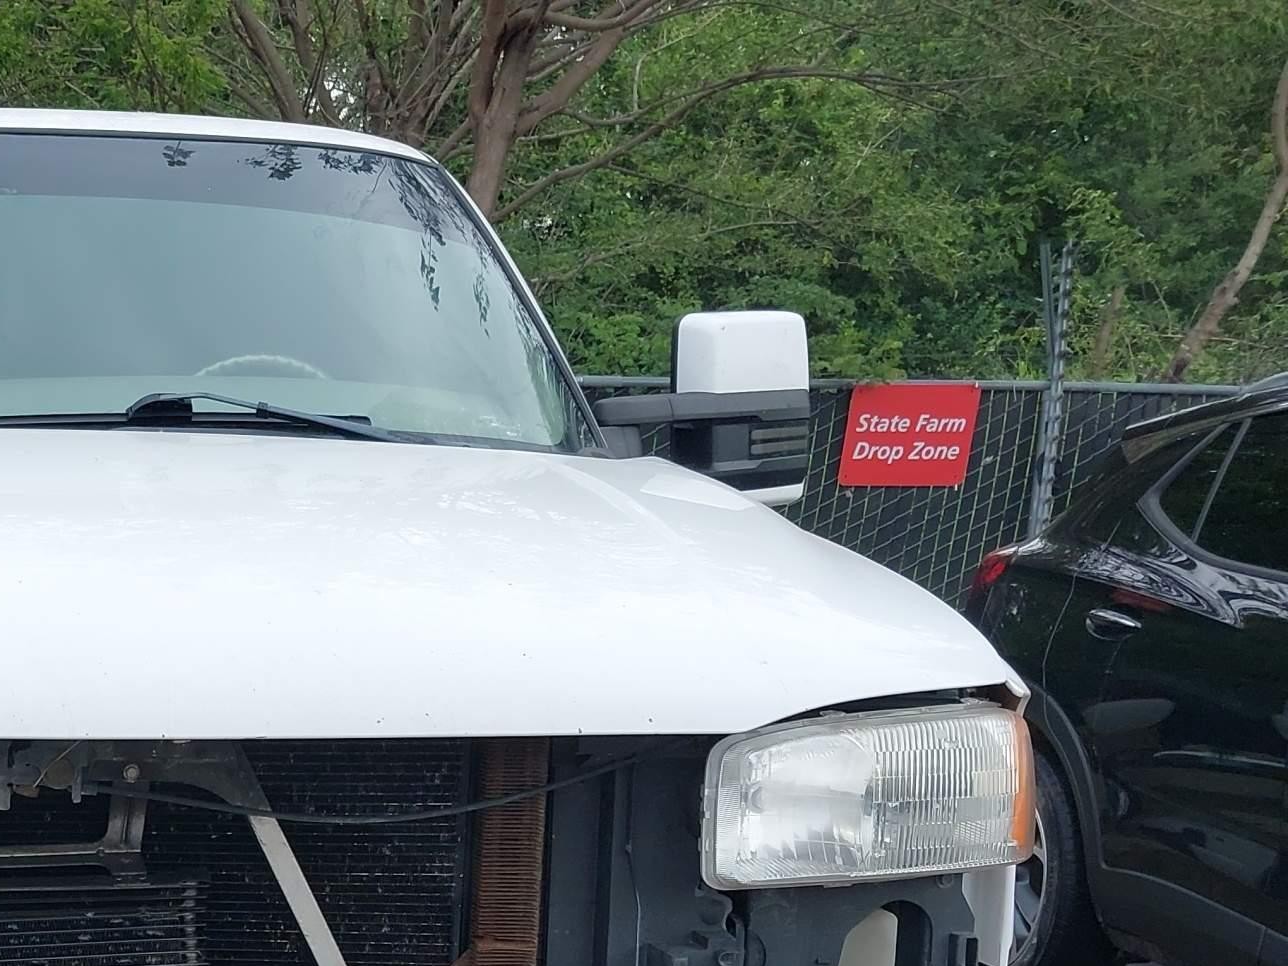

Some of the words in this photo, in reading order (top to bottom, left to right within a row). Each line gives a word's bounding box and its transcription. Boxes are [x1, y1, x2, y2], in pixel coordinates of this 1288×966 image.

[855, 414, 910, 432] State
[915, 414, 966, 432] Farm
[852, 442, 904, 465] Drop
[908, 442, 960, 460] Zone
